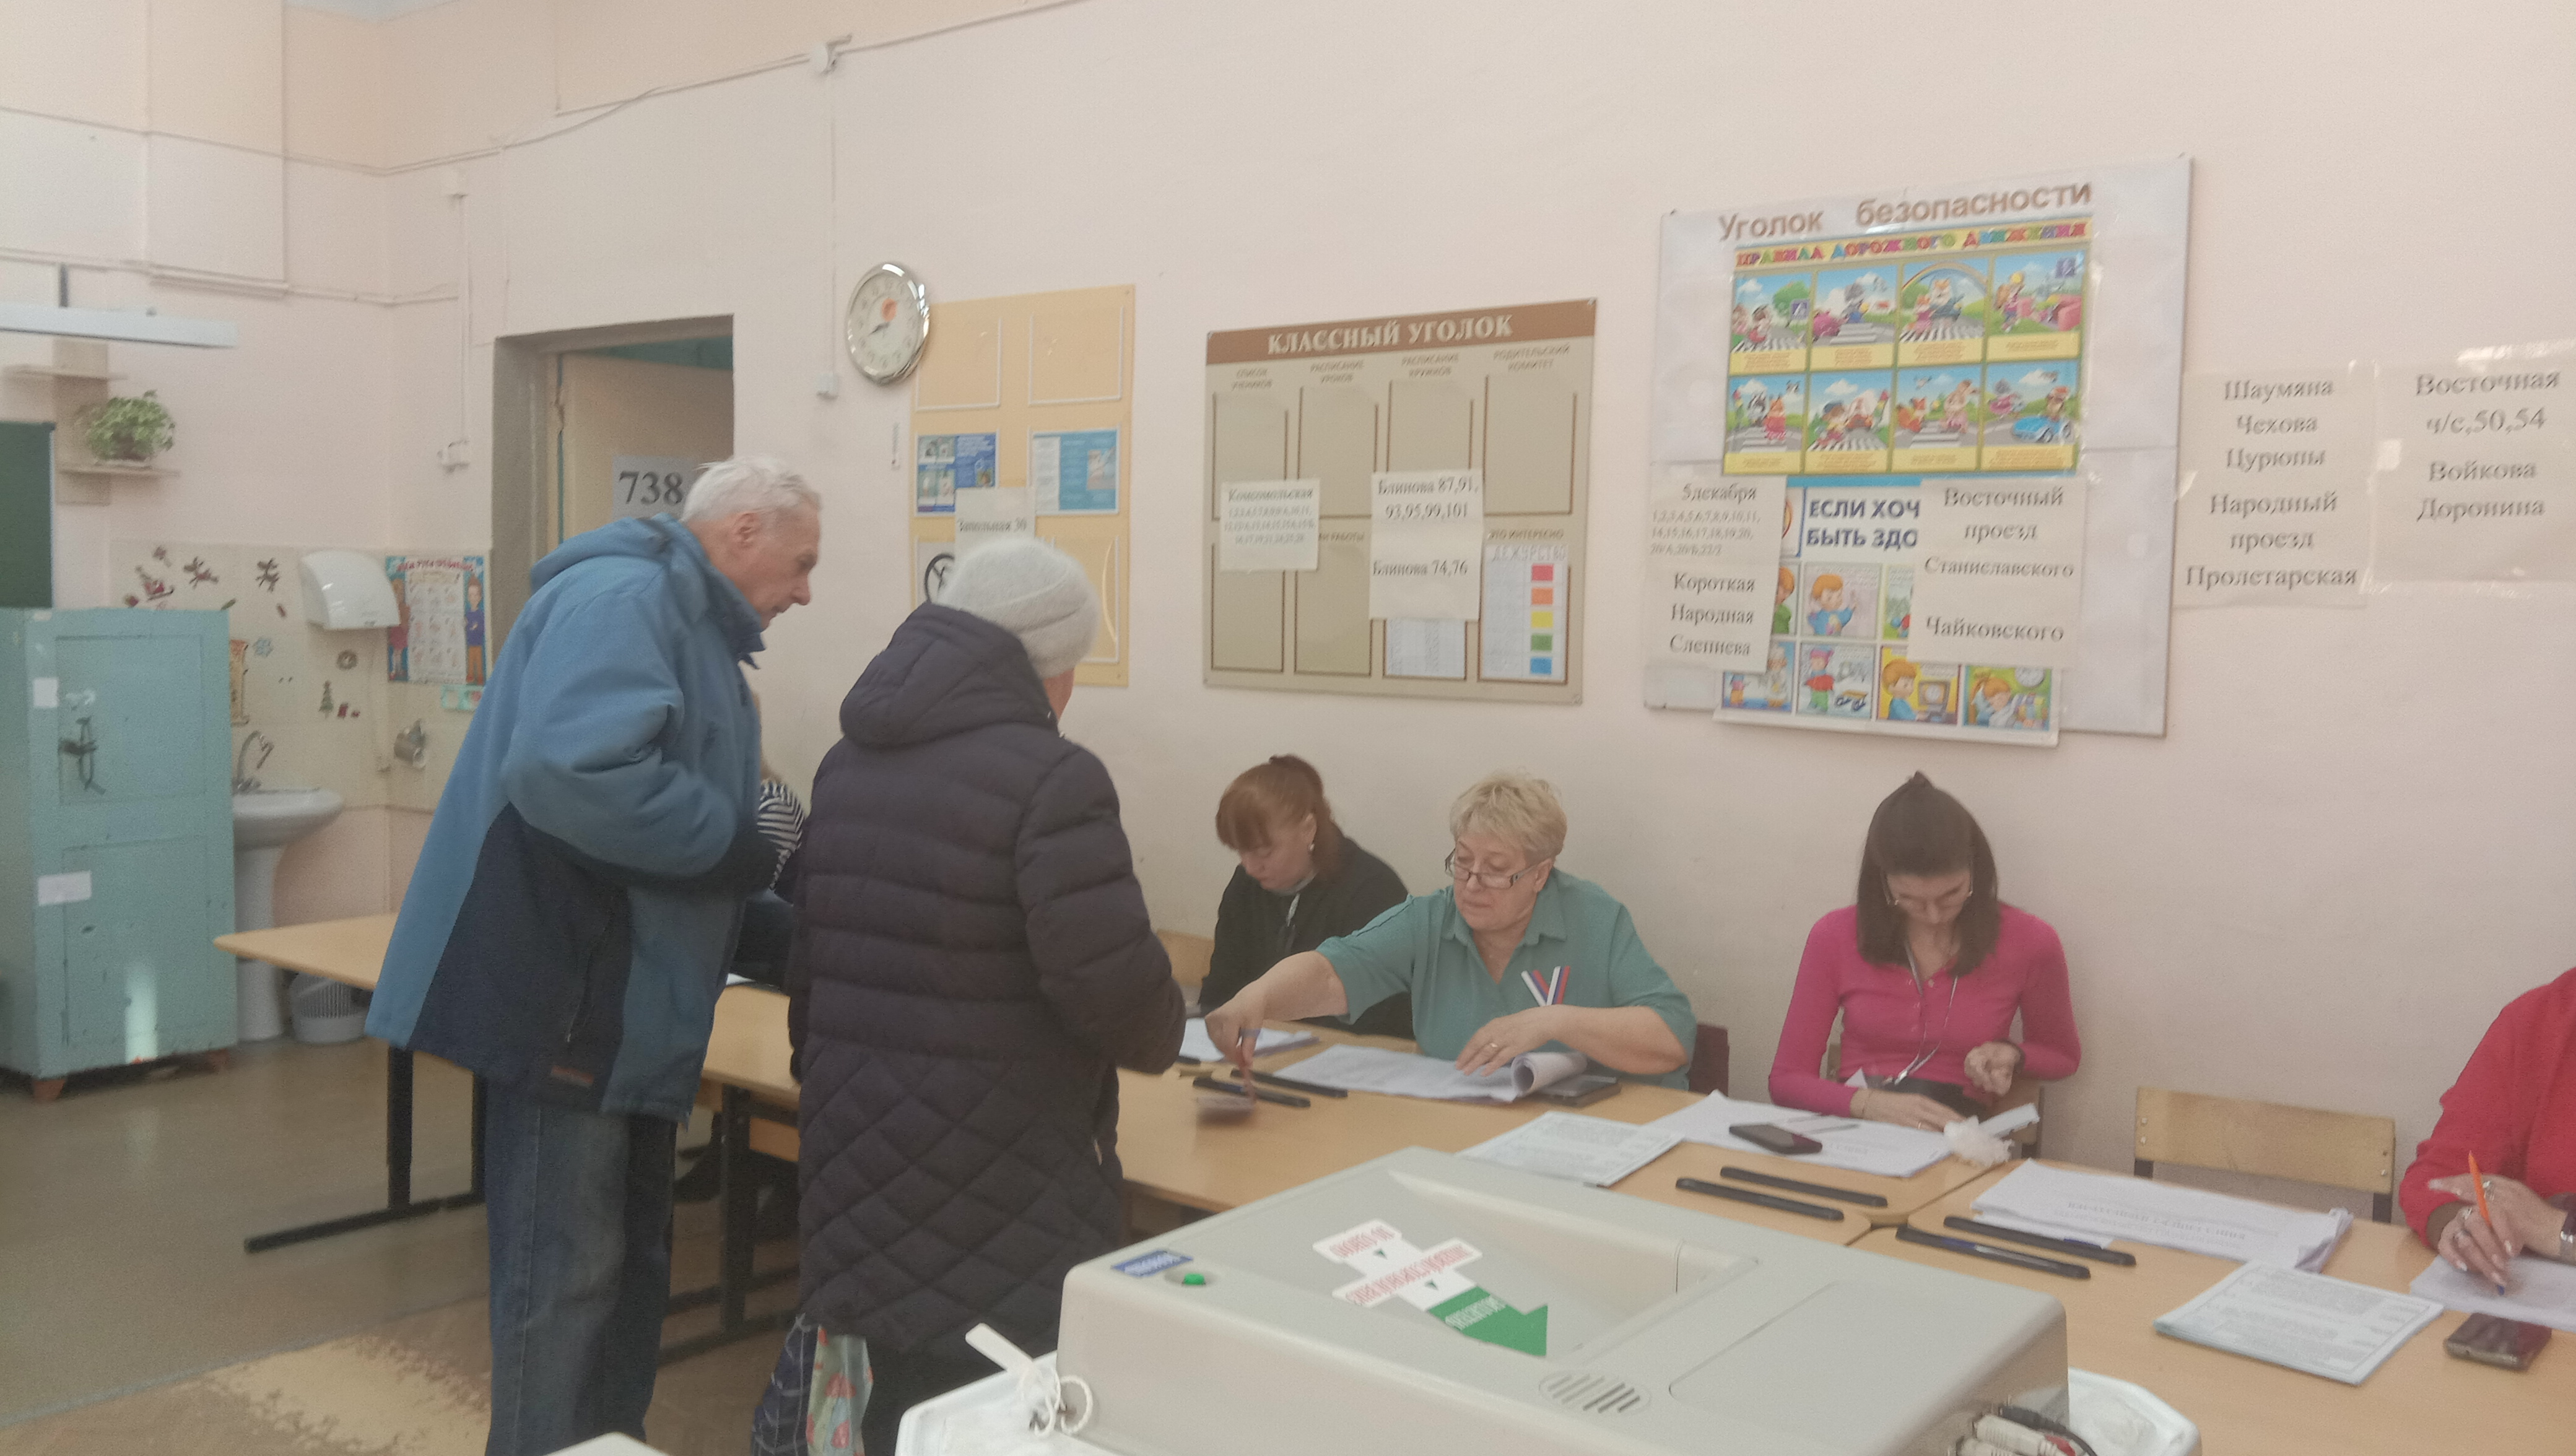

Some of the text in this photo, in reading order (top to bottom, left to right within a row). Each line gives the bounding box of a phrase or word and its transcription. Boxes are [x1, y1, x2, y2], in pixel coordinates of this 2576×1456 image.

[1720, 182, 2092, 242] Уголок безопасности
[1736, 223, 2086, 267] ПРАВИЛА ДОРОЖНОГО ДВИЖЕНИЯ
[1268, 314, 1513, 356] КЛАССНЫЙ УГОЛОК
[2224, 379, 2334, 404] Шаумяна
[2416, 370, 2561, 397] Восточная
[2237, 415, 2318, 435] Чехова
[2426, 407, 2547, 437] ч/с,50,54
[2226, 448, 2326, 472] Цурюпы
[2429, 460, 2537, 482] Войкова
[619, 470, 684, 505] 738
[1378, 480, 1435, 495] Блинова
[1944, 487, 2065, 507] Восточный
[1385, 503, 1468, 521] 93,95,99,101
[1809, 499, 1866, 518] ЕСЛИ
[2210, 491, 2338, 519] Народный
[2416, 497, 2546, 523] Доронина
[1806, 528, 1866, 547] БЫТЬ
[1964, 523, 2037, 544] проезд
[2230, 531, 2315, 555] проезд
[1373, 560, 1468, 577] Блинова 74,76
[1924, 556, 2074, 579] Станиславского
[2186, 565, 2357, 591] Пролетарская
[1673, 573, 1756, 593] Короткая
[1671, 605, 1755, 626] Народная
[1925, 616, 2065, 644] Чайковского
[1670, 635, 1751, 656] Слепнева
